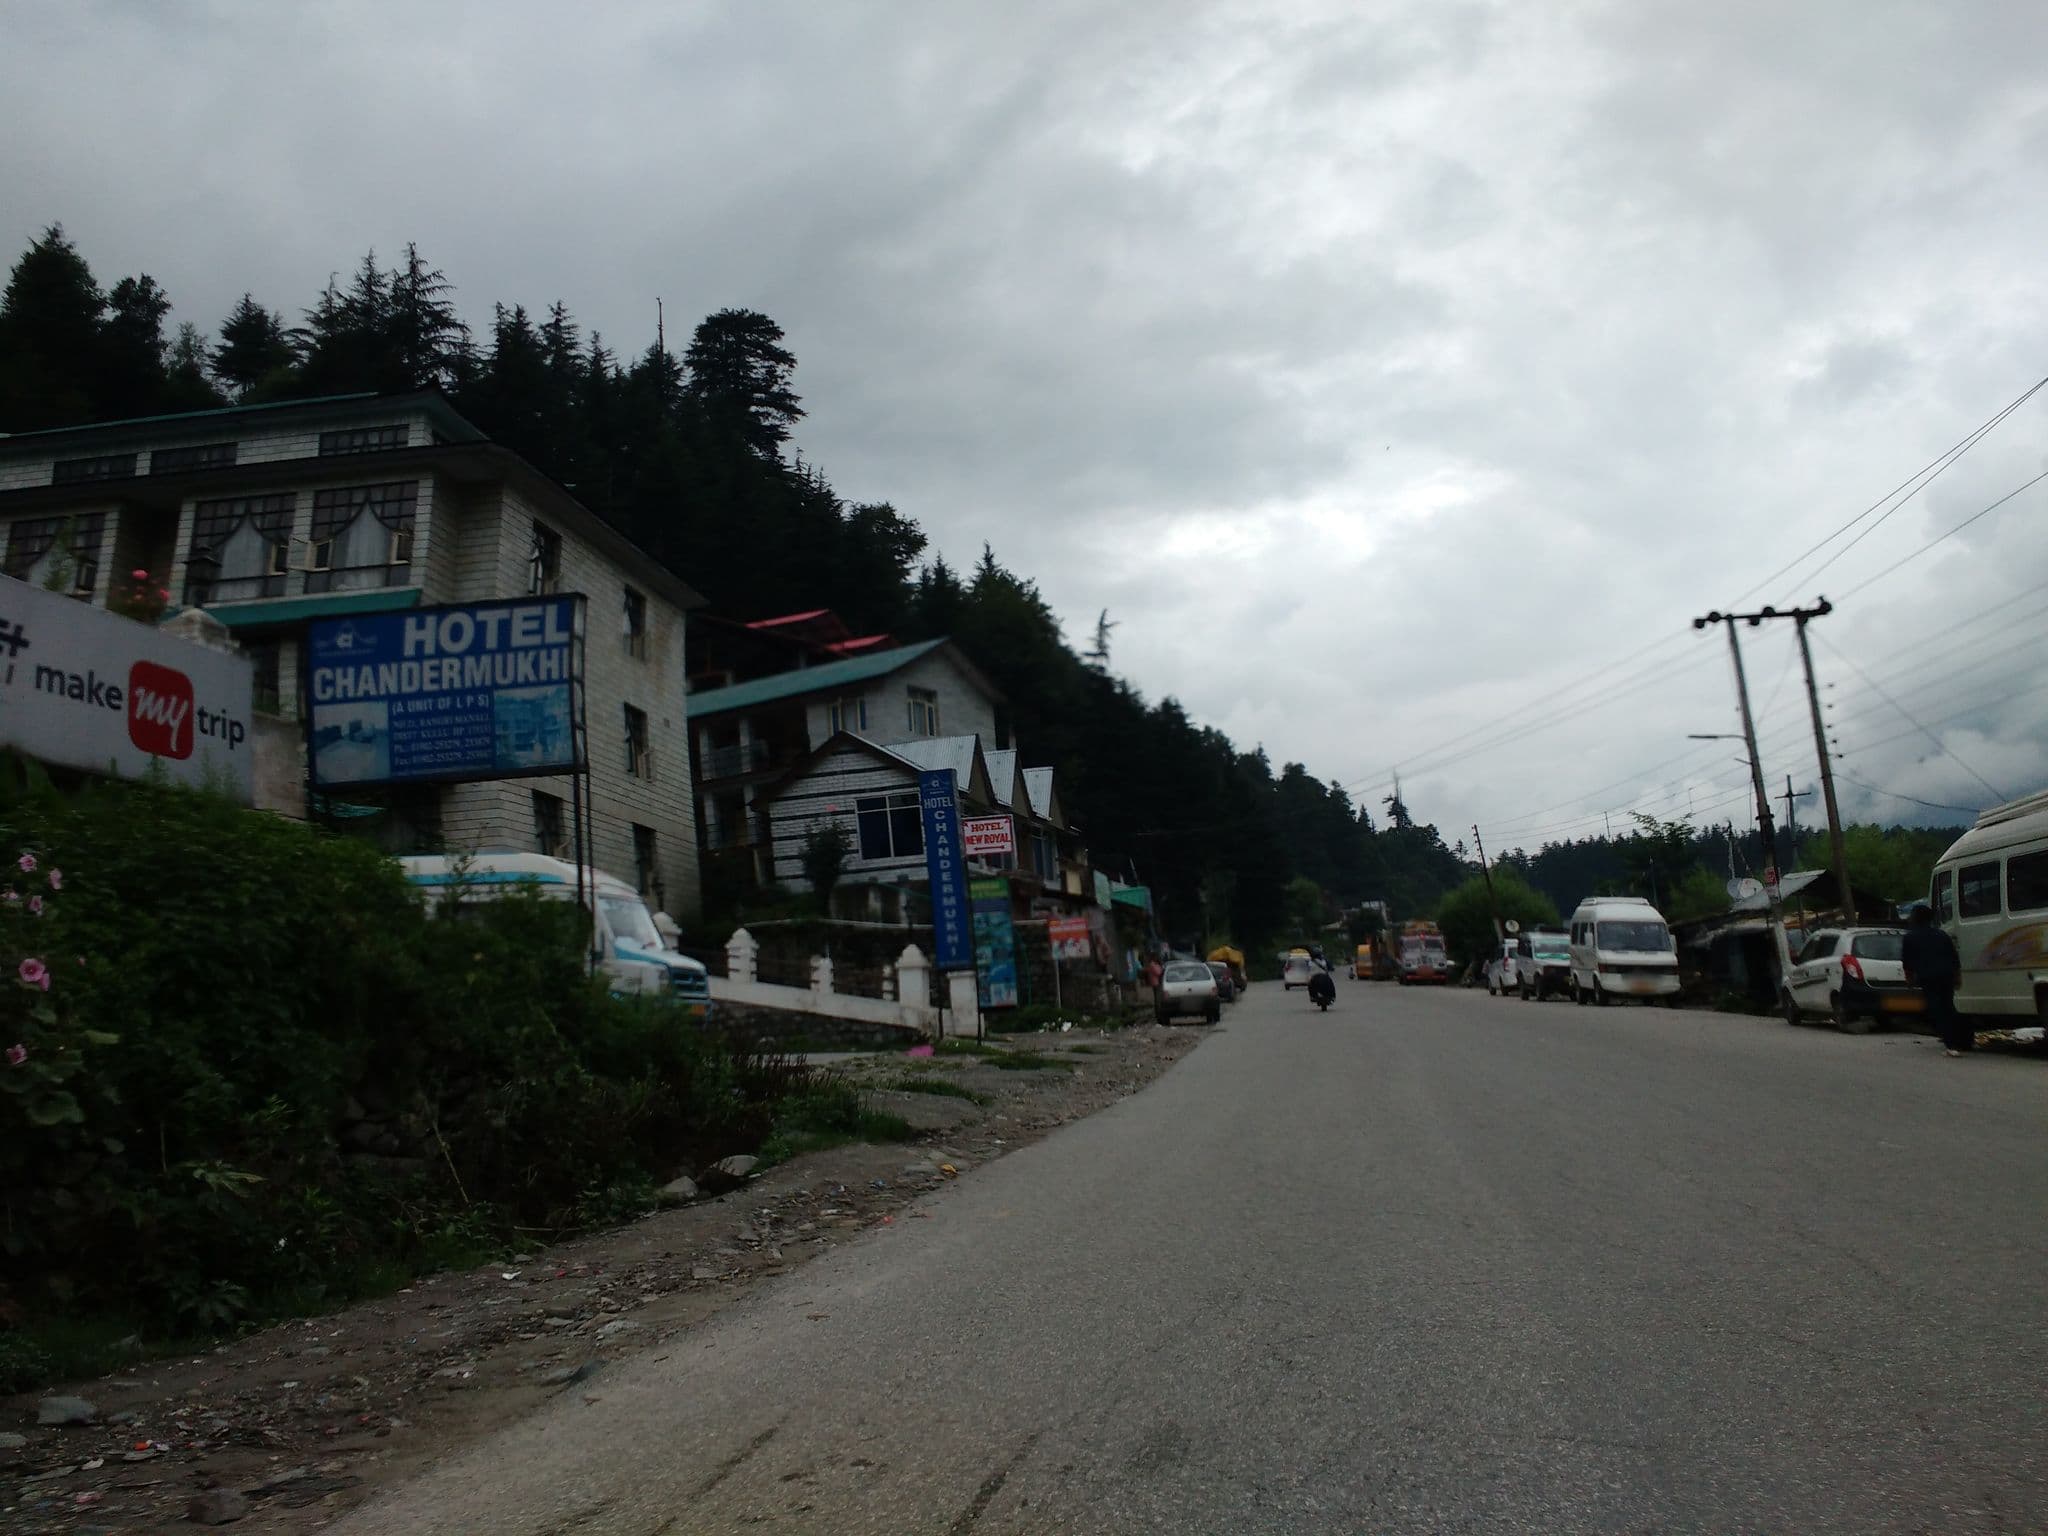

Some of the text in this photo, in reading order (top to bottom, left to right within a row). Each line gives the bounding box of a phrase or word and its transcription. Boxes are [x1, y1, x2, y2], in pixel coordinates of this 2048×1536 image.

[404, 603, 569, 656] HOTEL
[313, 647, 570, 700] CHANDERMUKHI
[35, 664, 244, 752] make my trip
[924, 796, 953, 809] HOTEL
[971, 822, 1004, 833] HOTEL
[965, 833, 1010, 845] NEW ROYAL
[934, 810, 959, 957] CHANDERMUKHI
